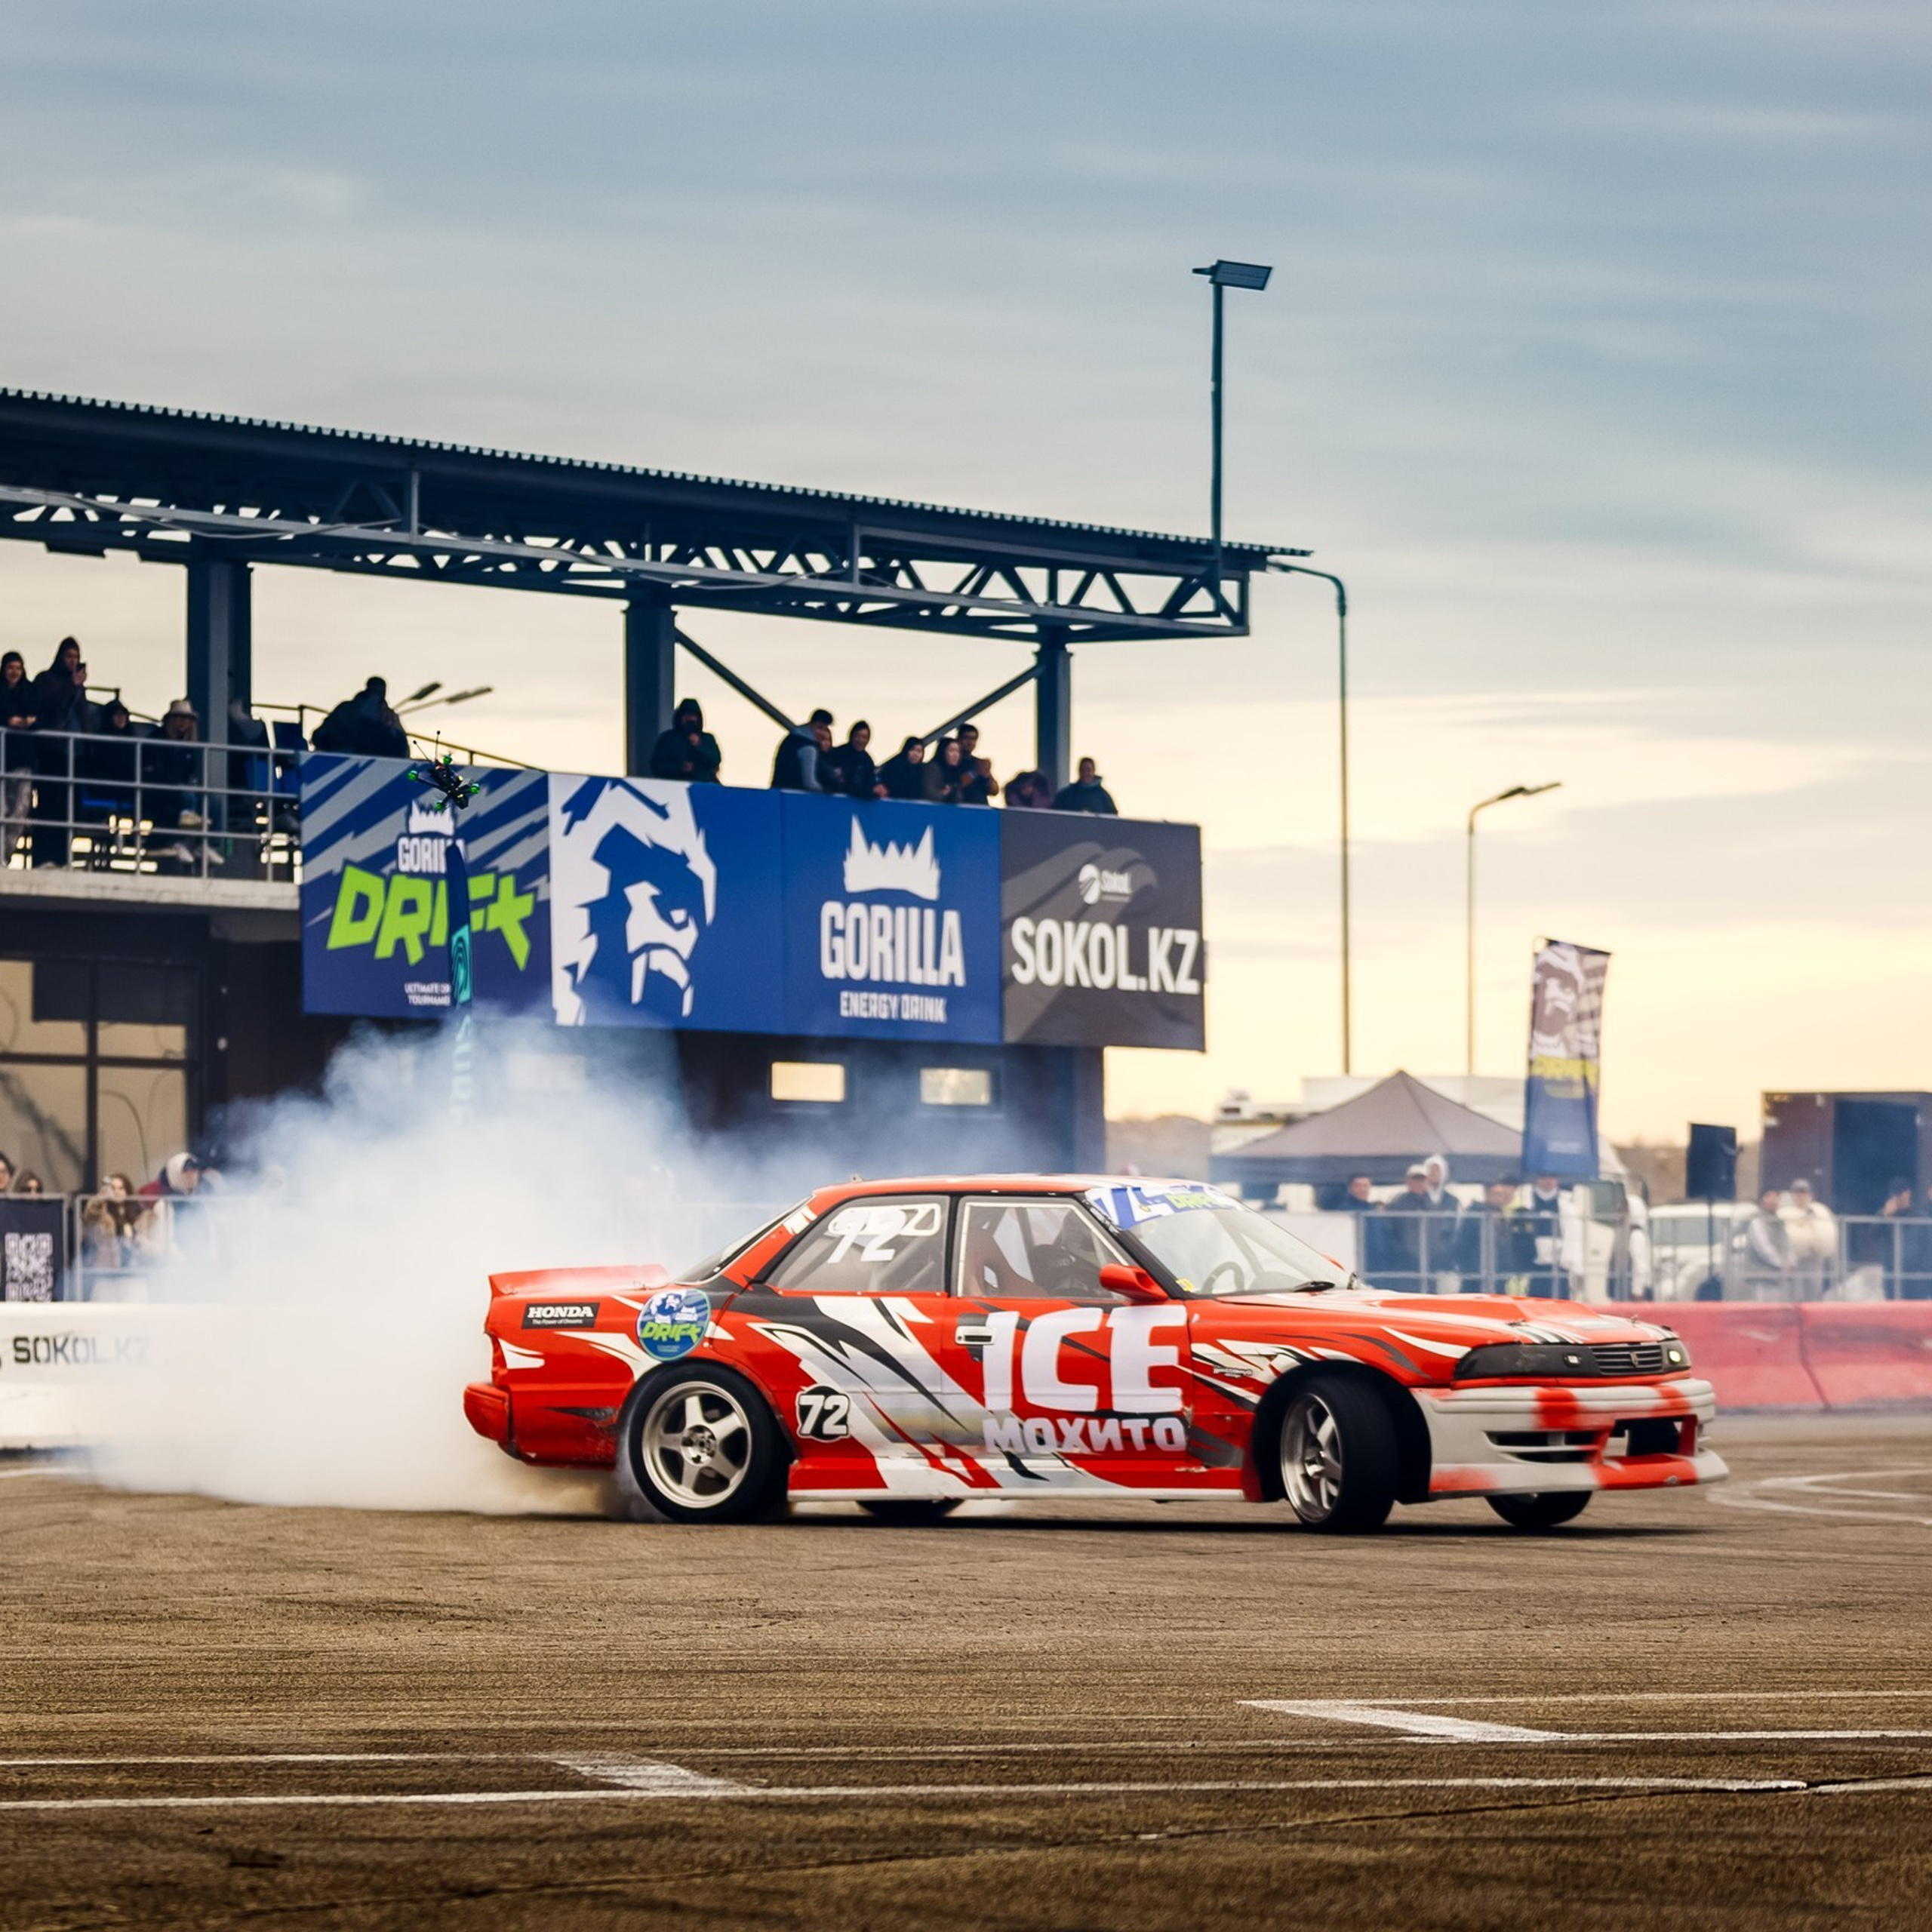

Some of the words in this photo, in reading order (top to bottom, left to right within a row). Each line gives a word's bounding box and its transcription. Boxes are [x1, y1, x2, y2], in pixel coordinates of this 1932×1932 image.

[820, 900, 967, 987] GORILLA
[1011, 917, 1200, 995] SOKOL.KZ
[840, 990, 899, 1020] ENERGY
[900, 994, 947, 1023] DRINK
[527, 1306, 595, 1318] HONDA
[641, 1321, 701, 1343] DRIFT
[983, 1305, 1187, 1413] ICE
[799, 1394, 849, 1435] 72
[983, 1417, 1186, 1454] МОХИТО
